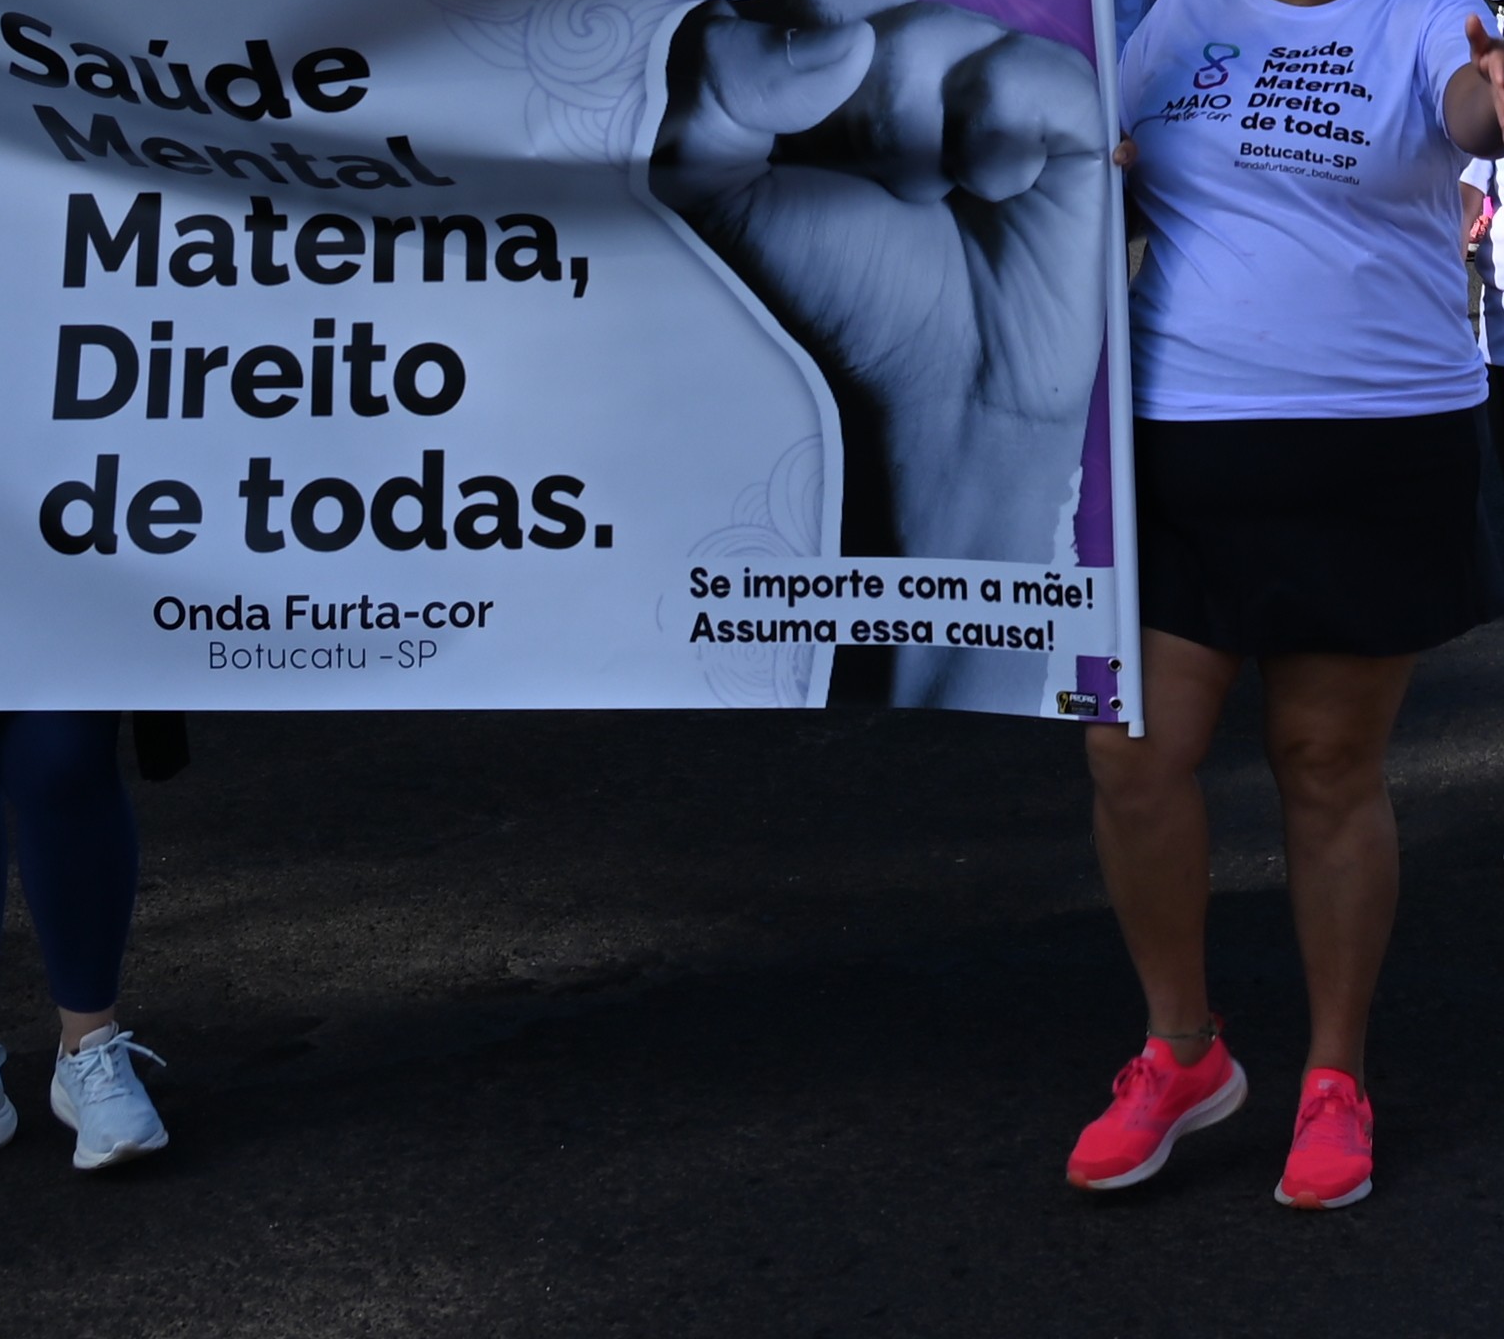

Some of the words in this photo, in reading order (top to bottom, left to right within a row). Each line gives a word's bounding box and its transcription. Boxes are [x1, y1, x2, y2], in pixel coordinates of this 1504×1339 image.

[0, 11, 371, 121] Saúde
[1263, 59, 1355, 75] Mental
[1268, 42, 1354, 59] Saúde
[1160, 94, 1232, 114] MAIO
[1247, 92, 1340, 116] Direito
[1254, 75, 1373, 103] Materna,
[1240, 112, 1276, 131] de
[1284, 117, 1372, 146] todas.
[32, 104, 457, 190] Mental
[1240, 142, 1357, 170] Botucatu-SP
[62, 191, 589, 298] Materna,
[52, 318, 467, 420] Direito
[39, 453, 203, 556] de
[239, 449, 614, 554] todas.
[689, 567, 731, 598] Se
[743, 567, 885, 607] importe
[898, 574, 968, 600] com
[980, 577, 1001, 602] a
[1013, 572, 1094, 610] mãe!
[153, 595, 271, 631] Onda
[286, 595, 494, 630] Furta-cor
[689, 612, 837, 643] Assuma
[850, 619, 934, 644] essa
[946, 620, 1055, 651] causa!
[209, 641, 366, 669] Botucatu
